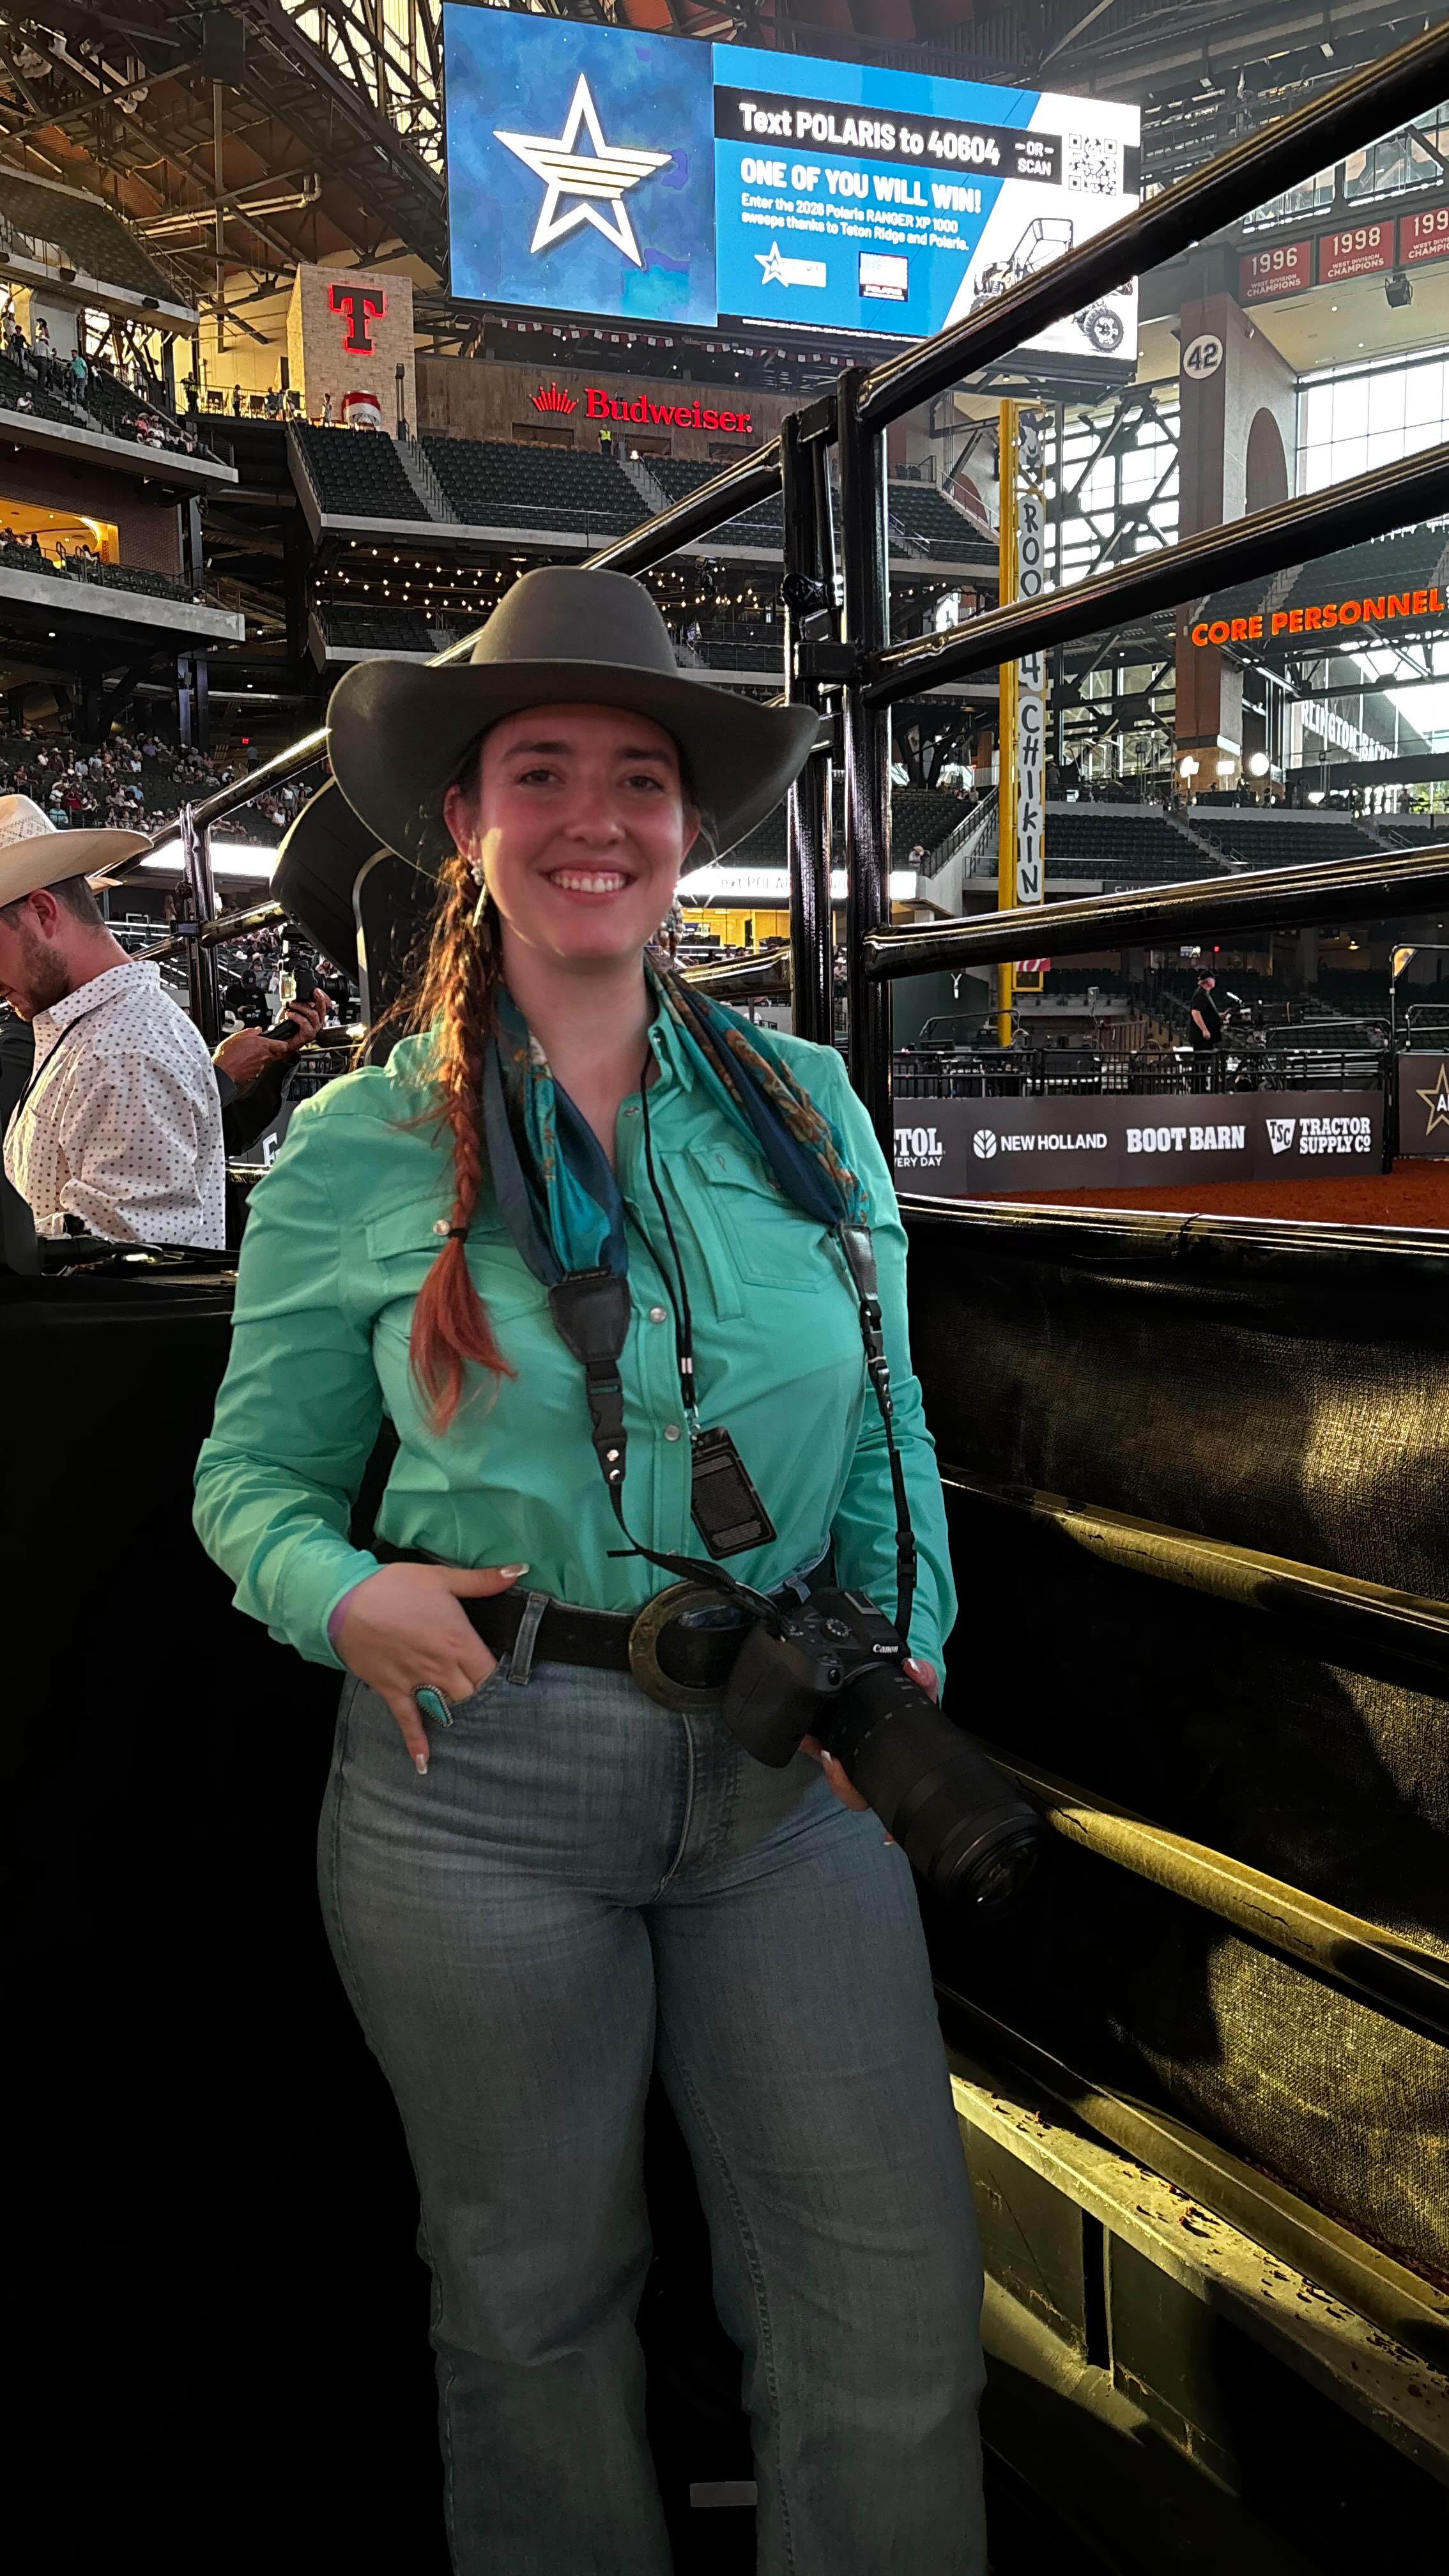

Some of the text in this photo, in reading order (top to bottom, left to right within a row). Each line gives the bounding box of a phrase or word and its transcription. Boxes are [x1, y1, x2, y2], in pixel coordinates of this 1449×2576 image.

[739, 103, 1001, 166] Text POLARIS to 40604
[1018, 158, 1052, 176] SCAN
[741, 157, 981, 213] ONE OF YOU WILL WIN!
[741, 192, 774, 210] Enter
[775, 197, 794, 212] the
[826, 204, 864, 222] Polaris
[866, 209, 914, 228] RANGER
[915, 215, 931, 230] XP
[932, 218, 959, 234] 1000
[1413, 210, 1449, 237] 199
[741, 211, 970, 251] sweeps thanks to Teton Ridge and Polaris.
[1332, 226, 1381, 256] 1998
[1413, 240, 1432, 250] WEST
[1251, 247, 1298, 276] 1996
[1328, 257, 1384, 279] CHAMPIONS
[1331, 252, 1380, 270] WEST DIVISION
[1246, 277, 1301, 298] CHAMPIONS
[1251, 273, 1298, 289] WEST DIVISION
[330, 284, 385, 353] T
[1187, 342, 1218, 371] 42
[1021, 503, 1042, 598] ROO
[1192, 588, 1445, 647] CORE PERSONNEL
[1021, 704, 1039, 894] CHIKIN
[1126, 1125, 1246, 1153] BOOT BARN
[1270, 1121, 1291, 1147] TSC
[1300, 1117, 1370, 1136] TRACTOR
[894, 1128, 942, 1156] TOL
[1000, 1133, 1108, 1151] NEW HOLLAND
[1300, 1135, 1354, 1154] SUPPLY
[920, 1156, 943, 1167] DAY
[873, 1643, 899, 1653] Canon
